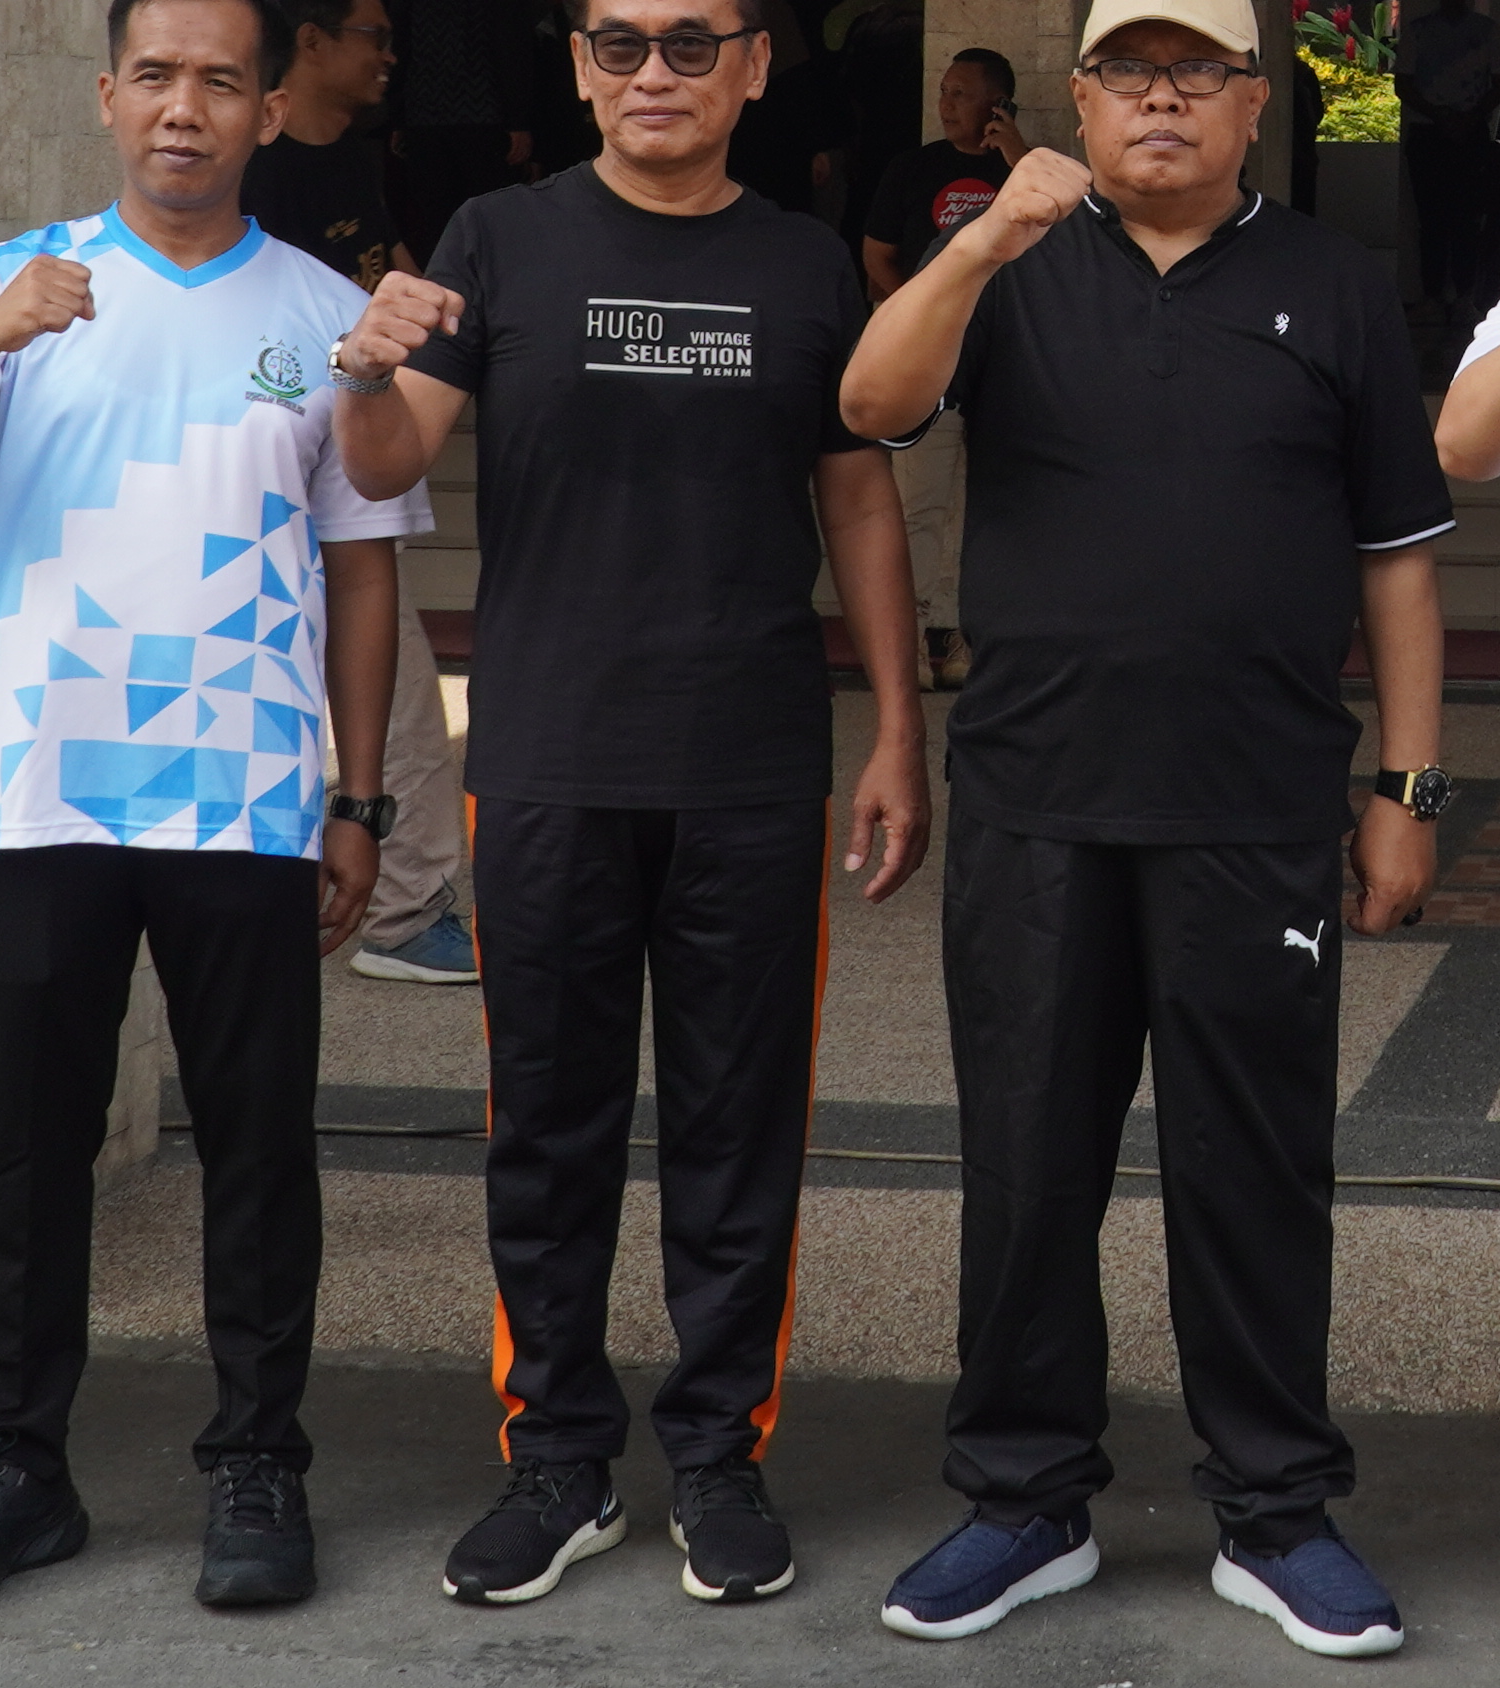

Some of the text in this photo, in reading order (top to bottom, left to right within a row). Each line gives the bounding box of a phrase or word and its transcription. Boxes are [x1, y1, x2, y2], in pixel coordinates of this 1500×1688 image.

[946, 192, 996, 202] BERANI
[587, 310, 664, 341] HUGO
[690, 331, 752, 346] VINTAGE
[623, 344, 752, 365] SELECTION
[703, 367, 752, 377] DENIM
